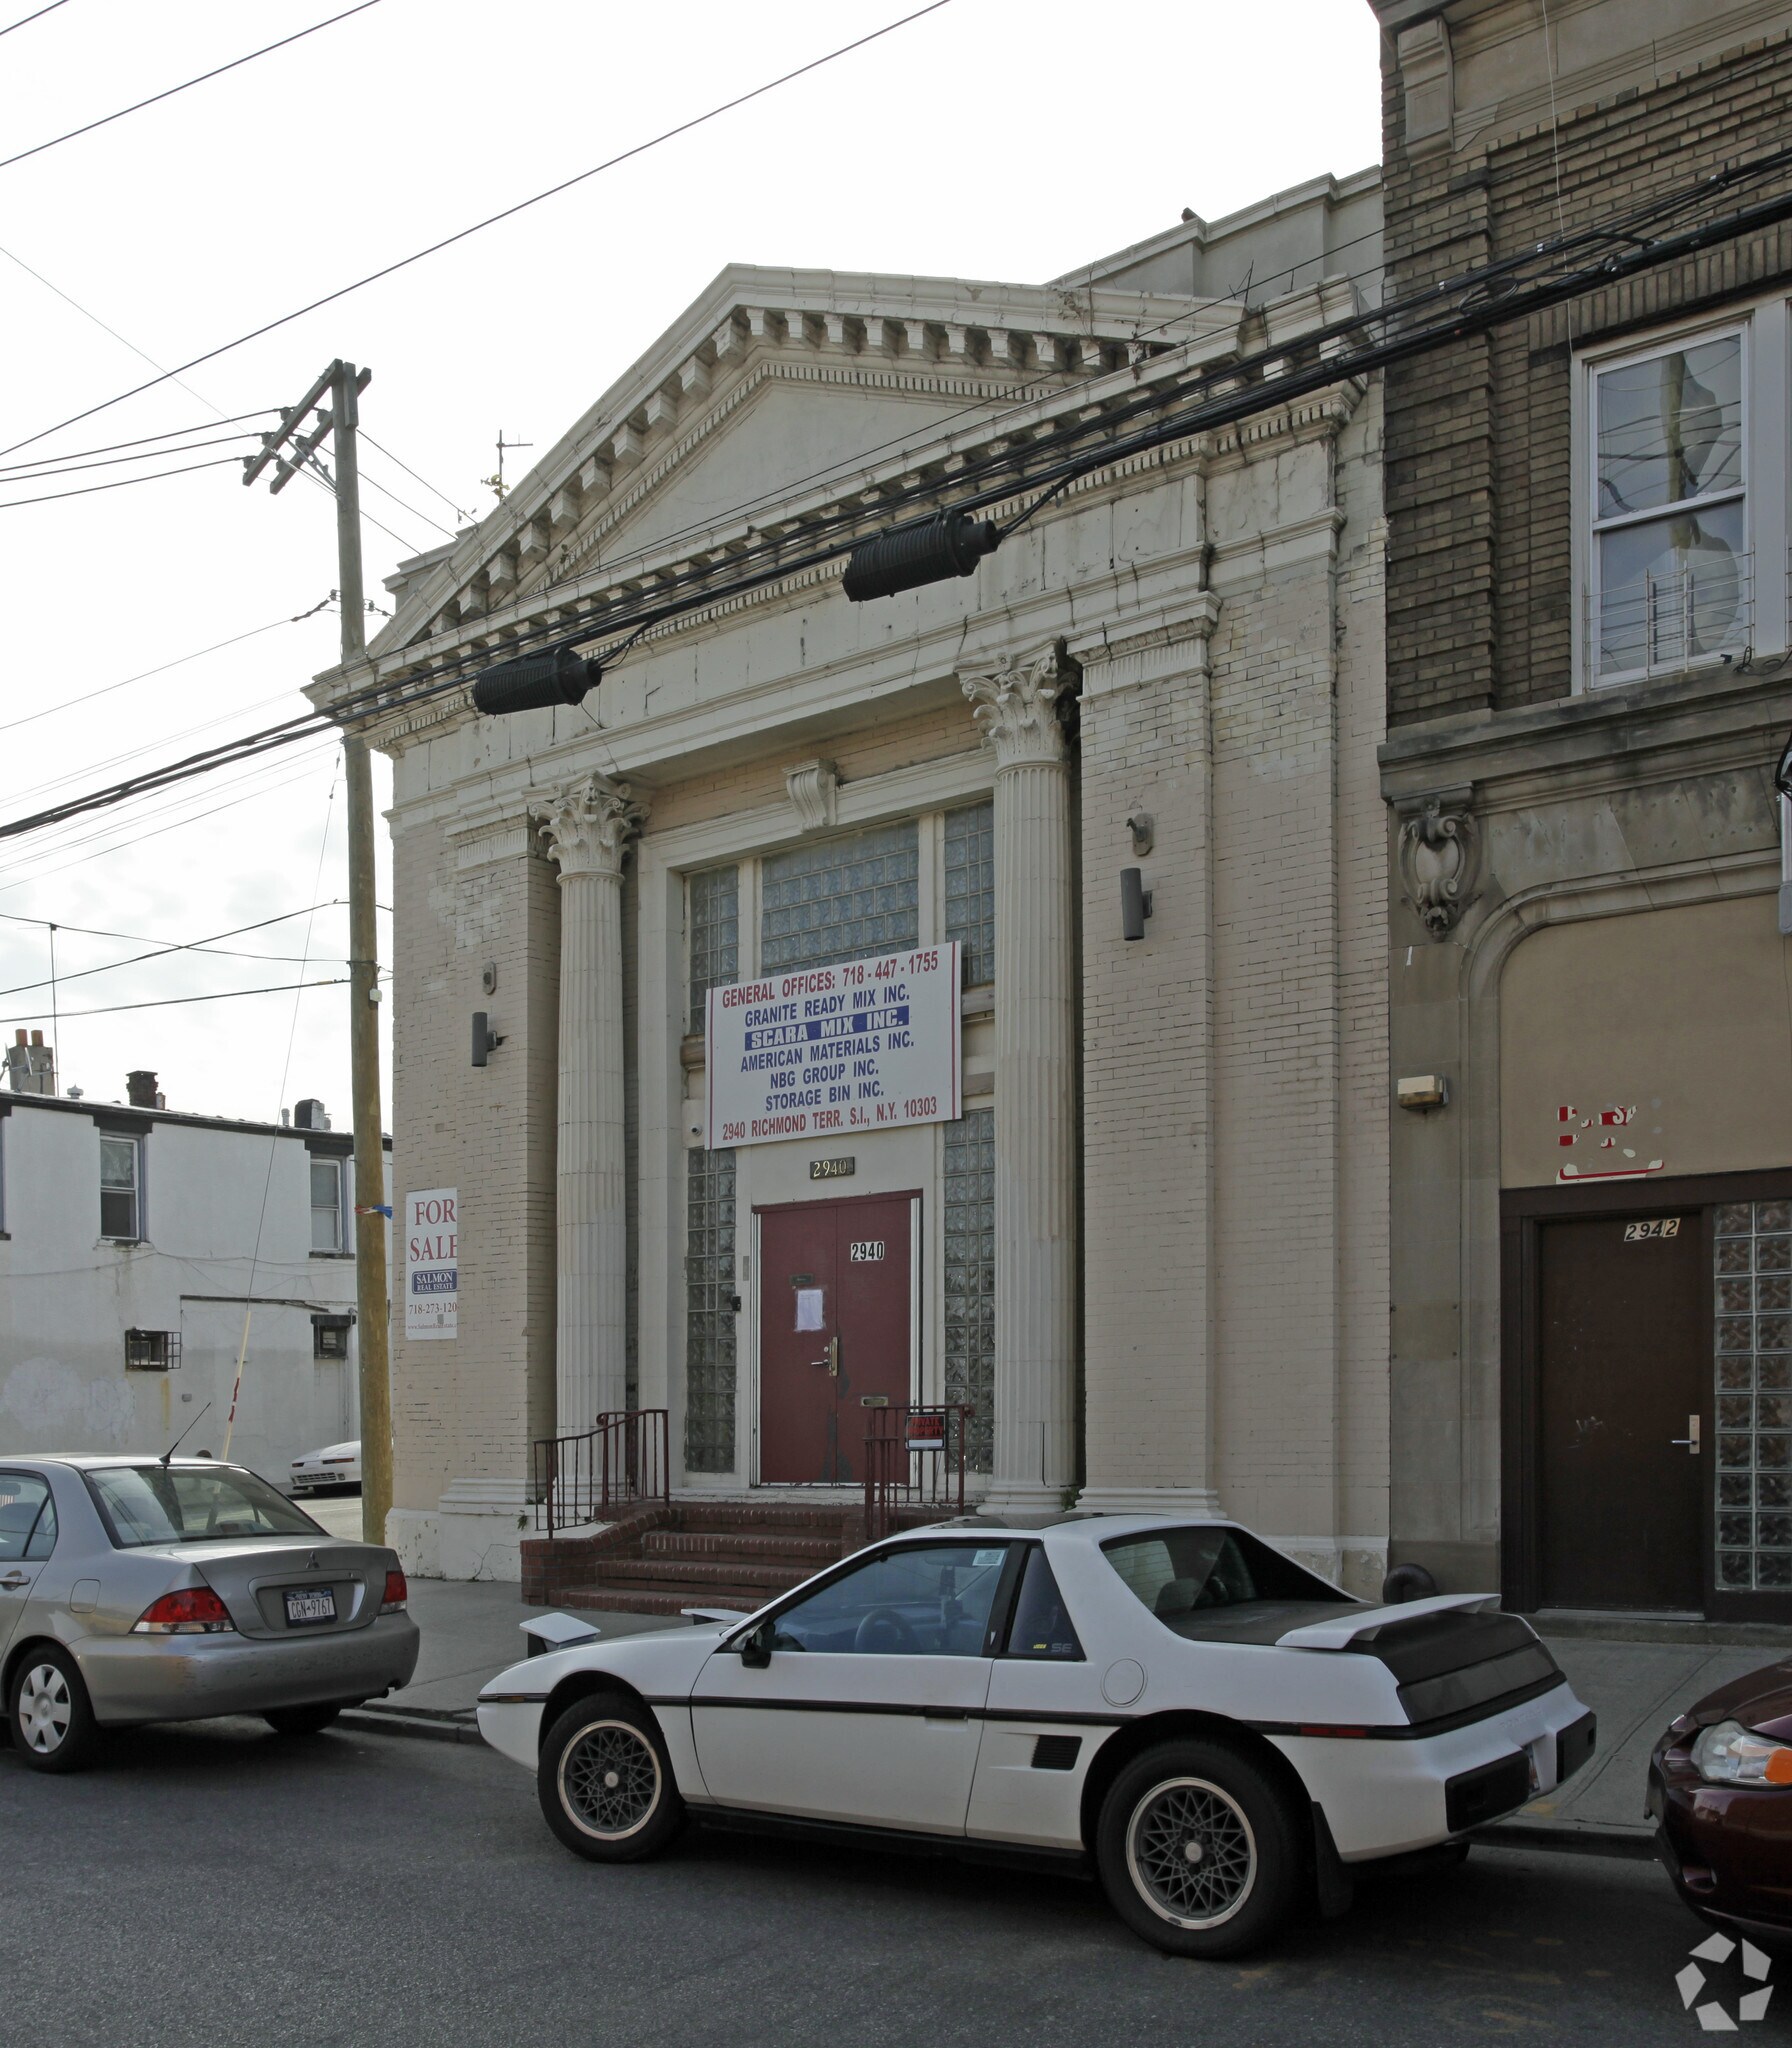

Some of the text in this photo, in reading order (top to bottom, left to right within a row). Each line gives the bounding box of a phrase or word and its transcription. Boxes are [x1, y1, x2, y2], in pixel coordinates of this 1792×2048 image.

[722, 985, 775, 1008] GENERAL
[782, 971, 835, 997] OFFICES:
[745, 984, 909, 1027] GRANITE READY MIX INC.
[751, 1008, 903, 1049] SCARA MIX INC.
[741, 1031, 914, 1072] AMERICAN MATERIALS INC.
[771, 1059, 878, 1089] NBG GROUP INC.
[766, 1081, 884, 1111] STORAGE BIN INC.
[723, 1121, 745, 1140] 2940
[752, 1114, 806, 1137] RICHMOND
[813, 1109, 843, 1128] TERR.
[877, 1102, 897, 1121] N.Y.
[904, 1097, 936, 1118] 10303
[813, 1159, 847, 1178] 2940
[415, 1199, 456, 1226] FOR
[1626, 1220, 1677, 1240] 2942
[410, 1235, 457, 1262] SALE
[852, 1242, 884, 1261] 2940
[416, 1272, 453, 1284] SALMON
